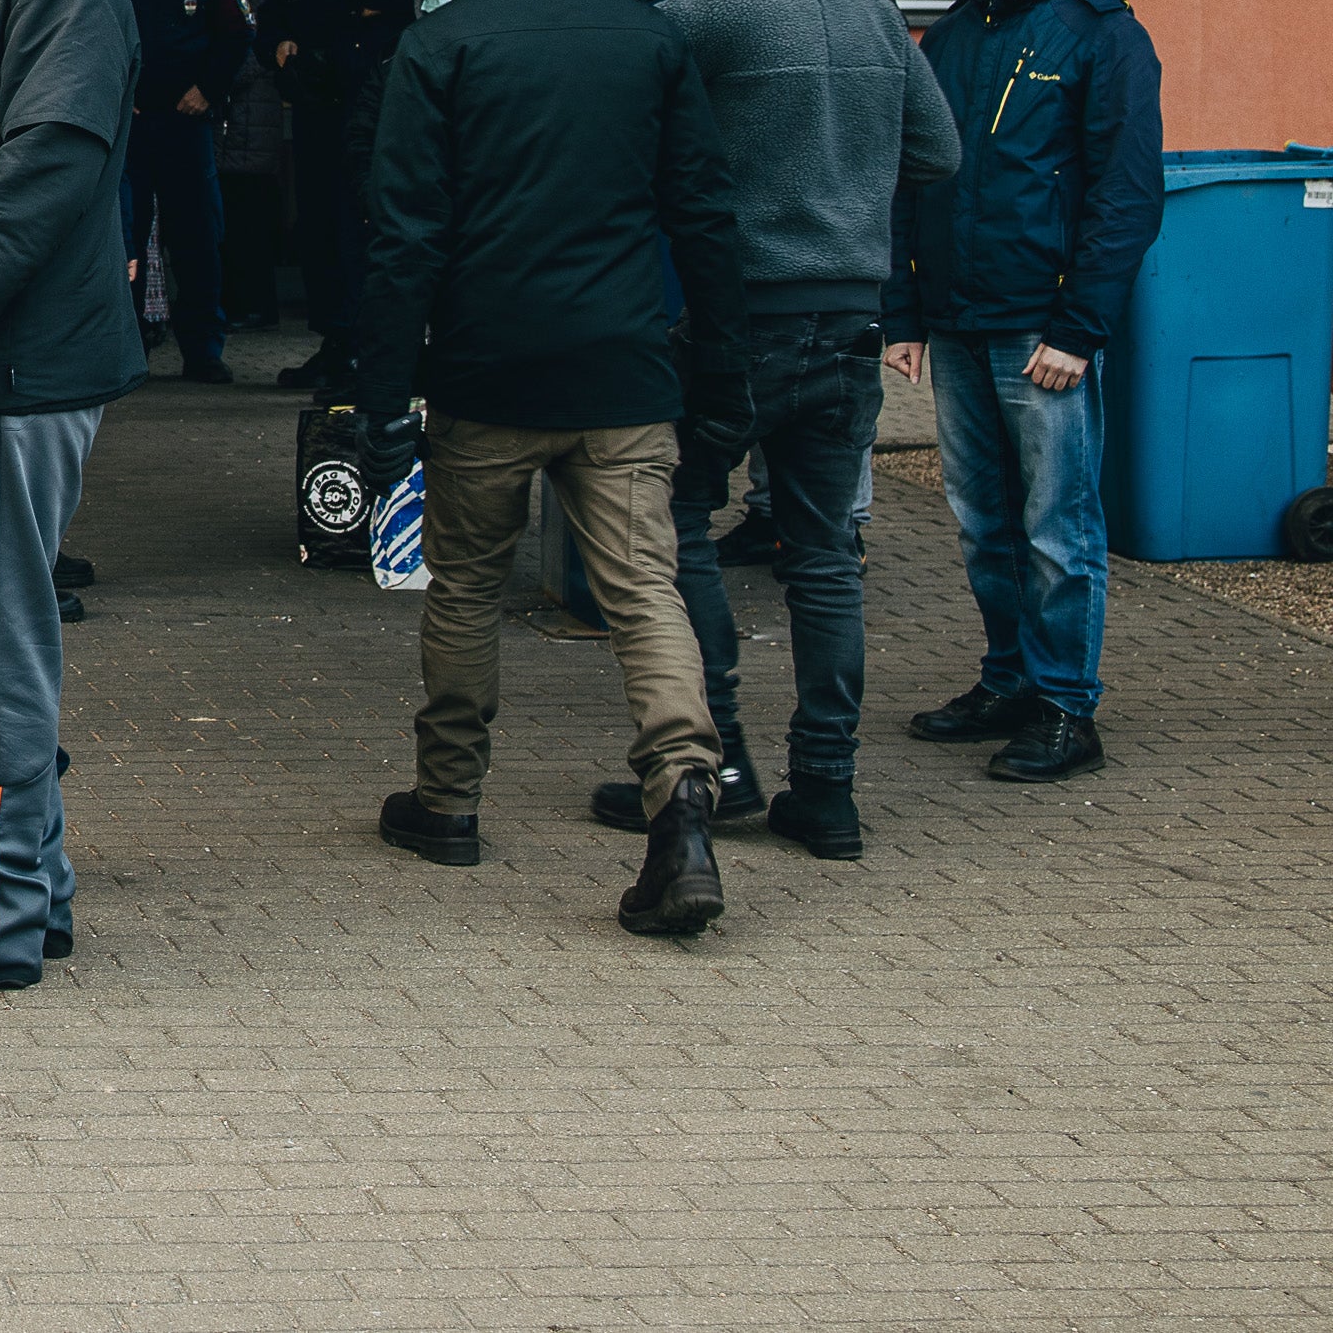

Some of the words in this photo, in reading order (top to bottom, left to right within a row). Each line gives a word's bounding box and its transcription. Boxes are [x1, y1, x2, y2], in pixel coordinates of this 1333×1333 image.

[314, 471, 338, 489] BAG
[323, 491, 348, 503] 50%
[348, 487, 360, 515] FOR
[313, 501, 339, 522] LIFE
